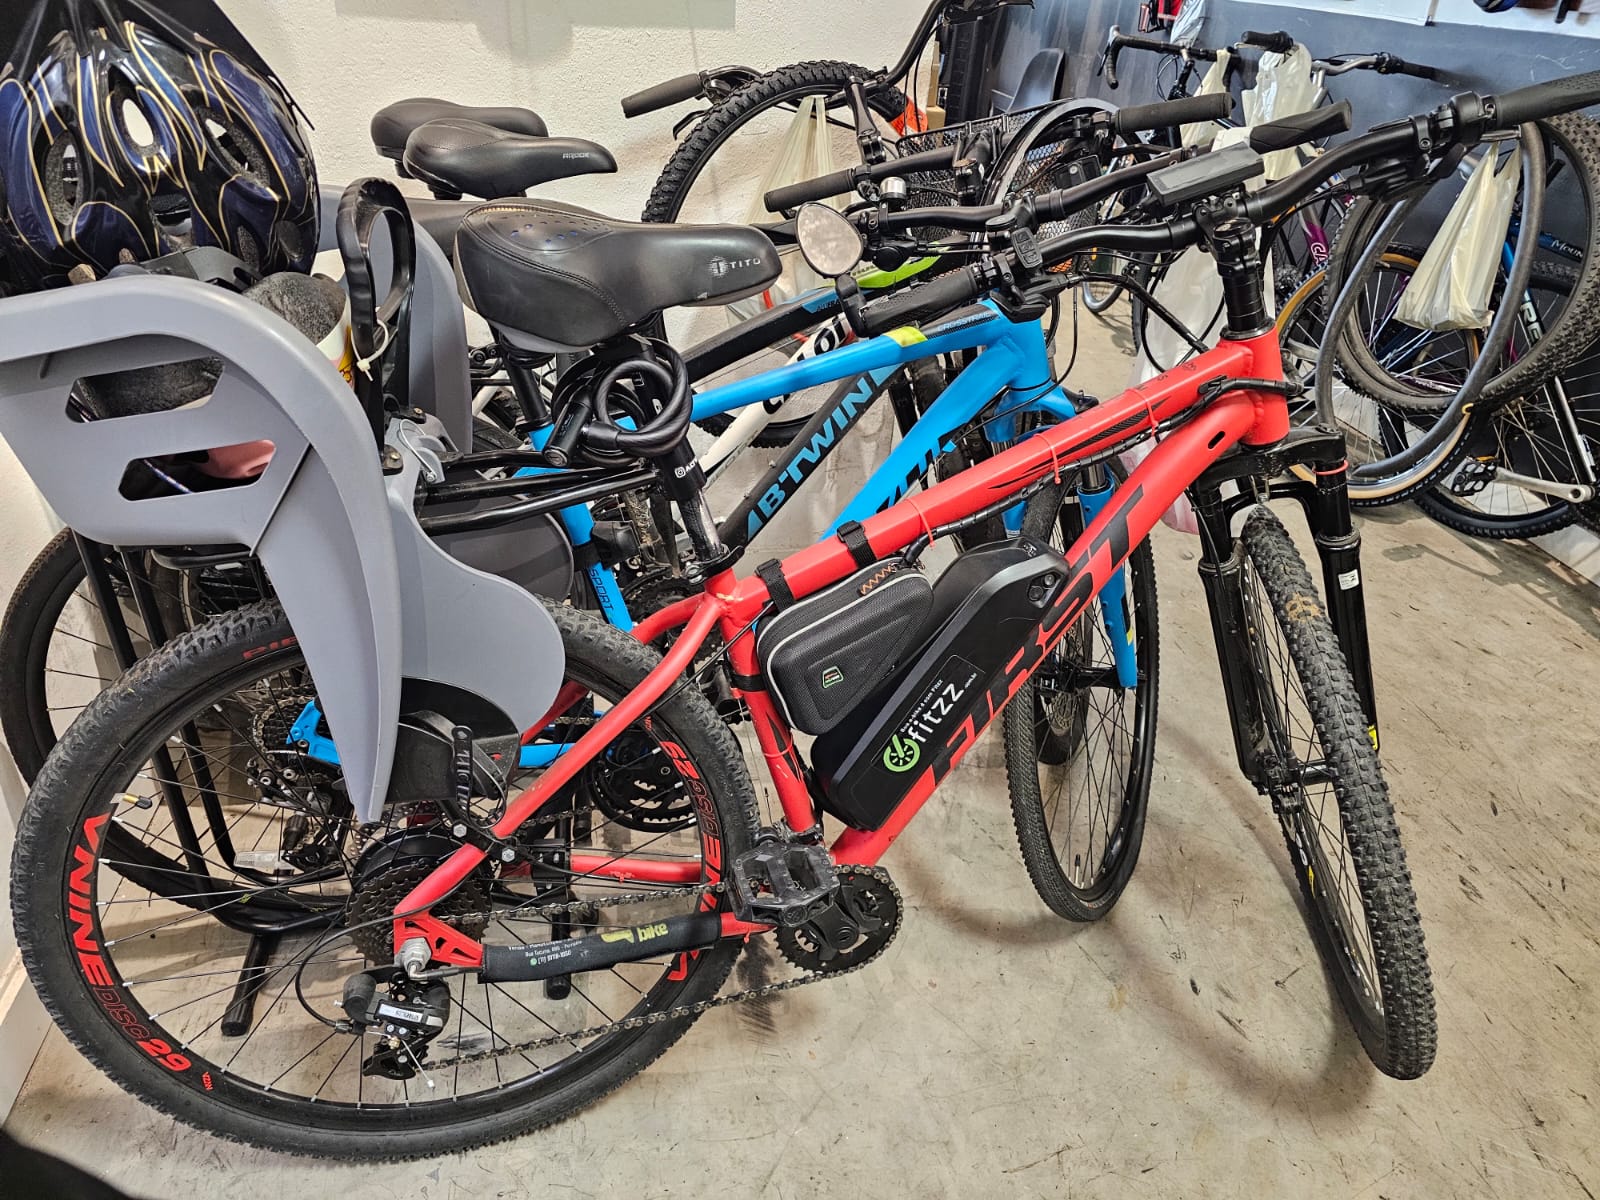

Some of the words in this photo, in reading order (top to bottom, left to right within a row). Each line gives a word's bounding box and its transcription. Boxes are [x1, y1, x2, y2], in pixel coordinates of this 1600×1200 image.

[729, 258, 761, 269] TITO
[590, 568, 614, 612] SPORT
[930, 483, 1144, 788] FIRST
[908, 683, 965, 743] fitzz
[659, 740, 701, 780] 29
[638, 923, 669, 942] bike
[93, 986, 150, 1040] DISC
[136, 1038, 192, 1072] 29
